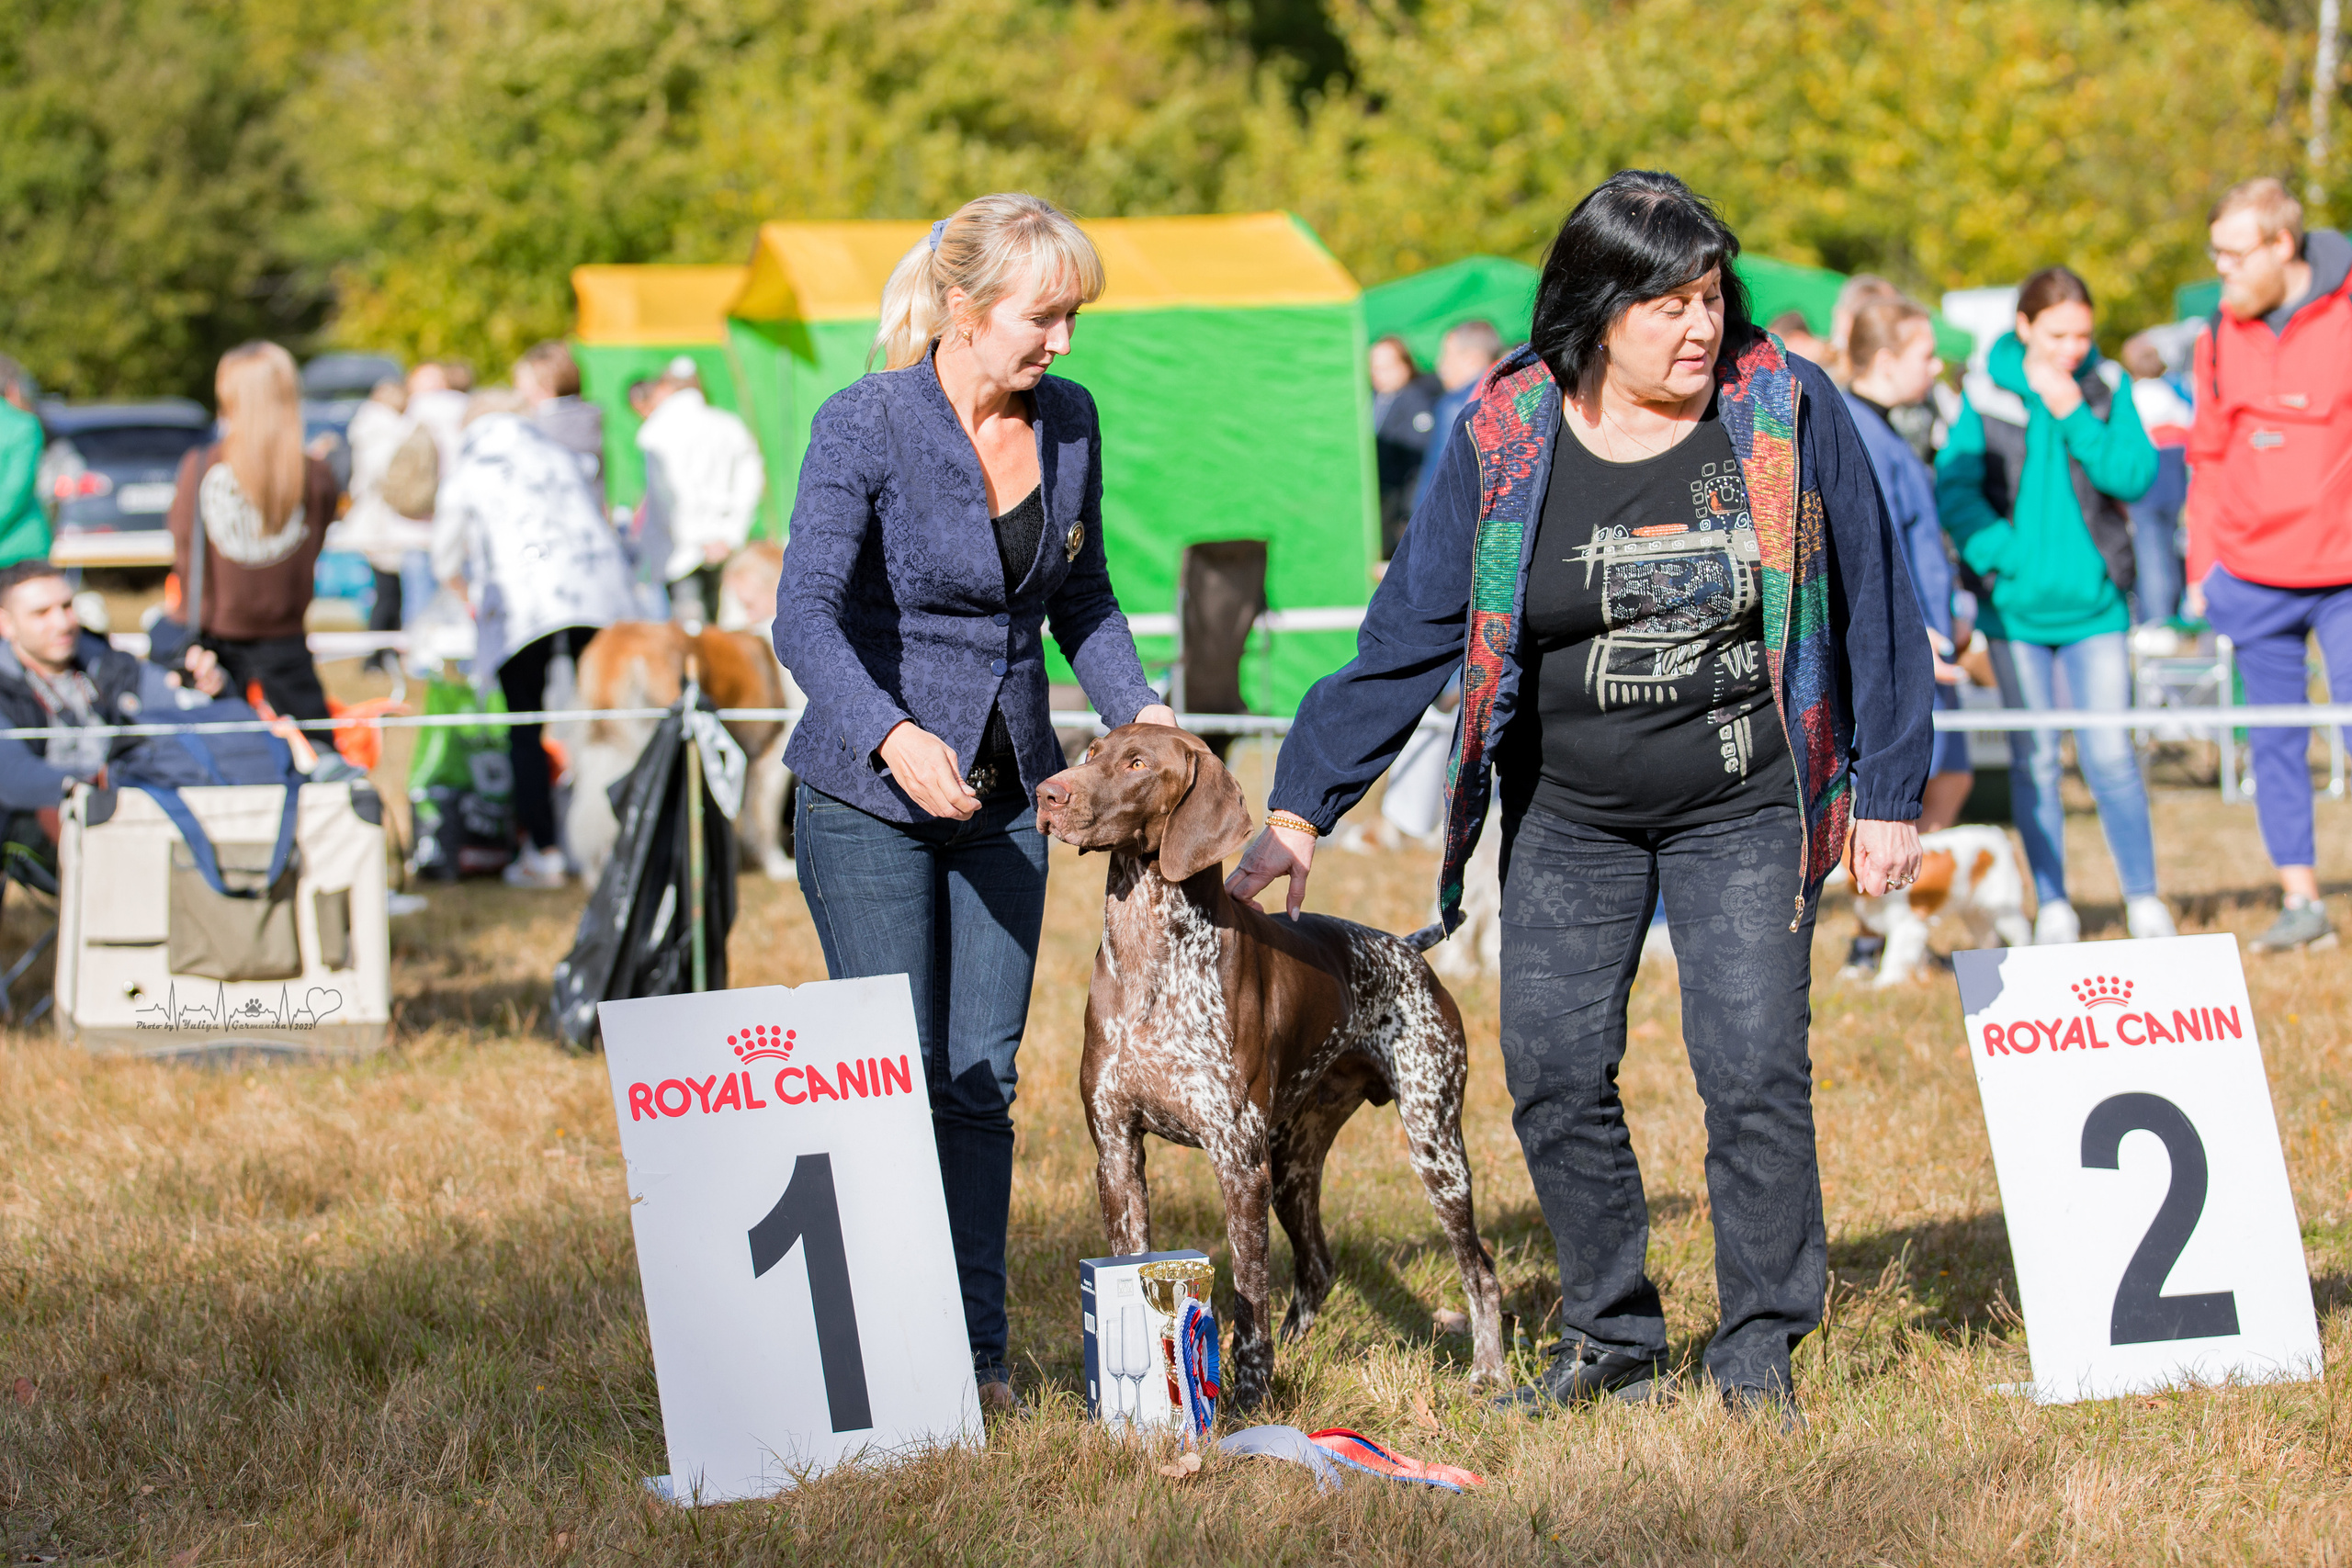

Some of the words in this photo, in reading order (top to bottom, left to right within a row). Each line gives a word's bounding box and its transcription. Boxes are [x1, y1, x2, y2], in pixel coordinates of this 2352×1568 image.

[628, 1070, 766, 1122] ROYAL
[774, 1054, 913, 1106] CANIN
[1983, 1015, 2109, 1057] ROYAL
[2116, 1005, 2243, 1046] CANIN
[747, 1152, 874, 1434] 1
[2081, 1092, 2241, 1346] 2
